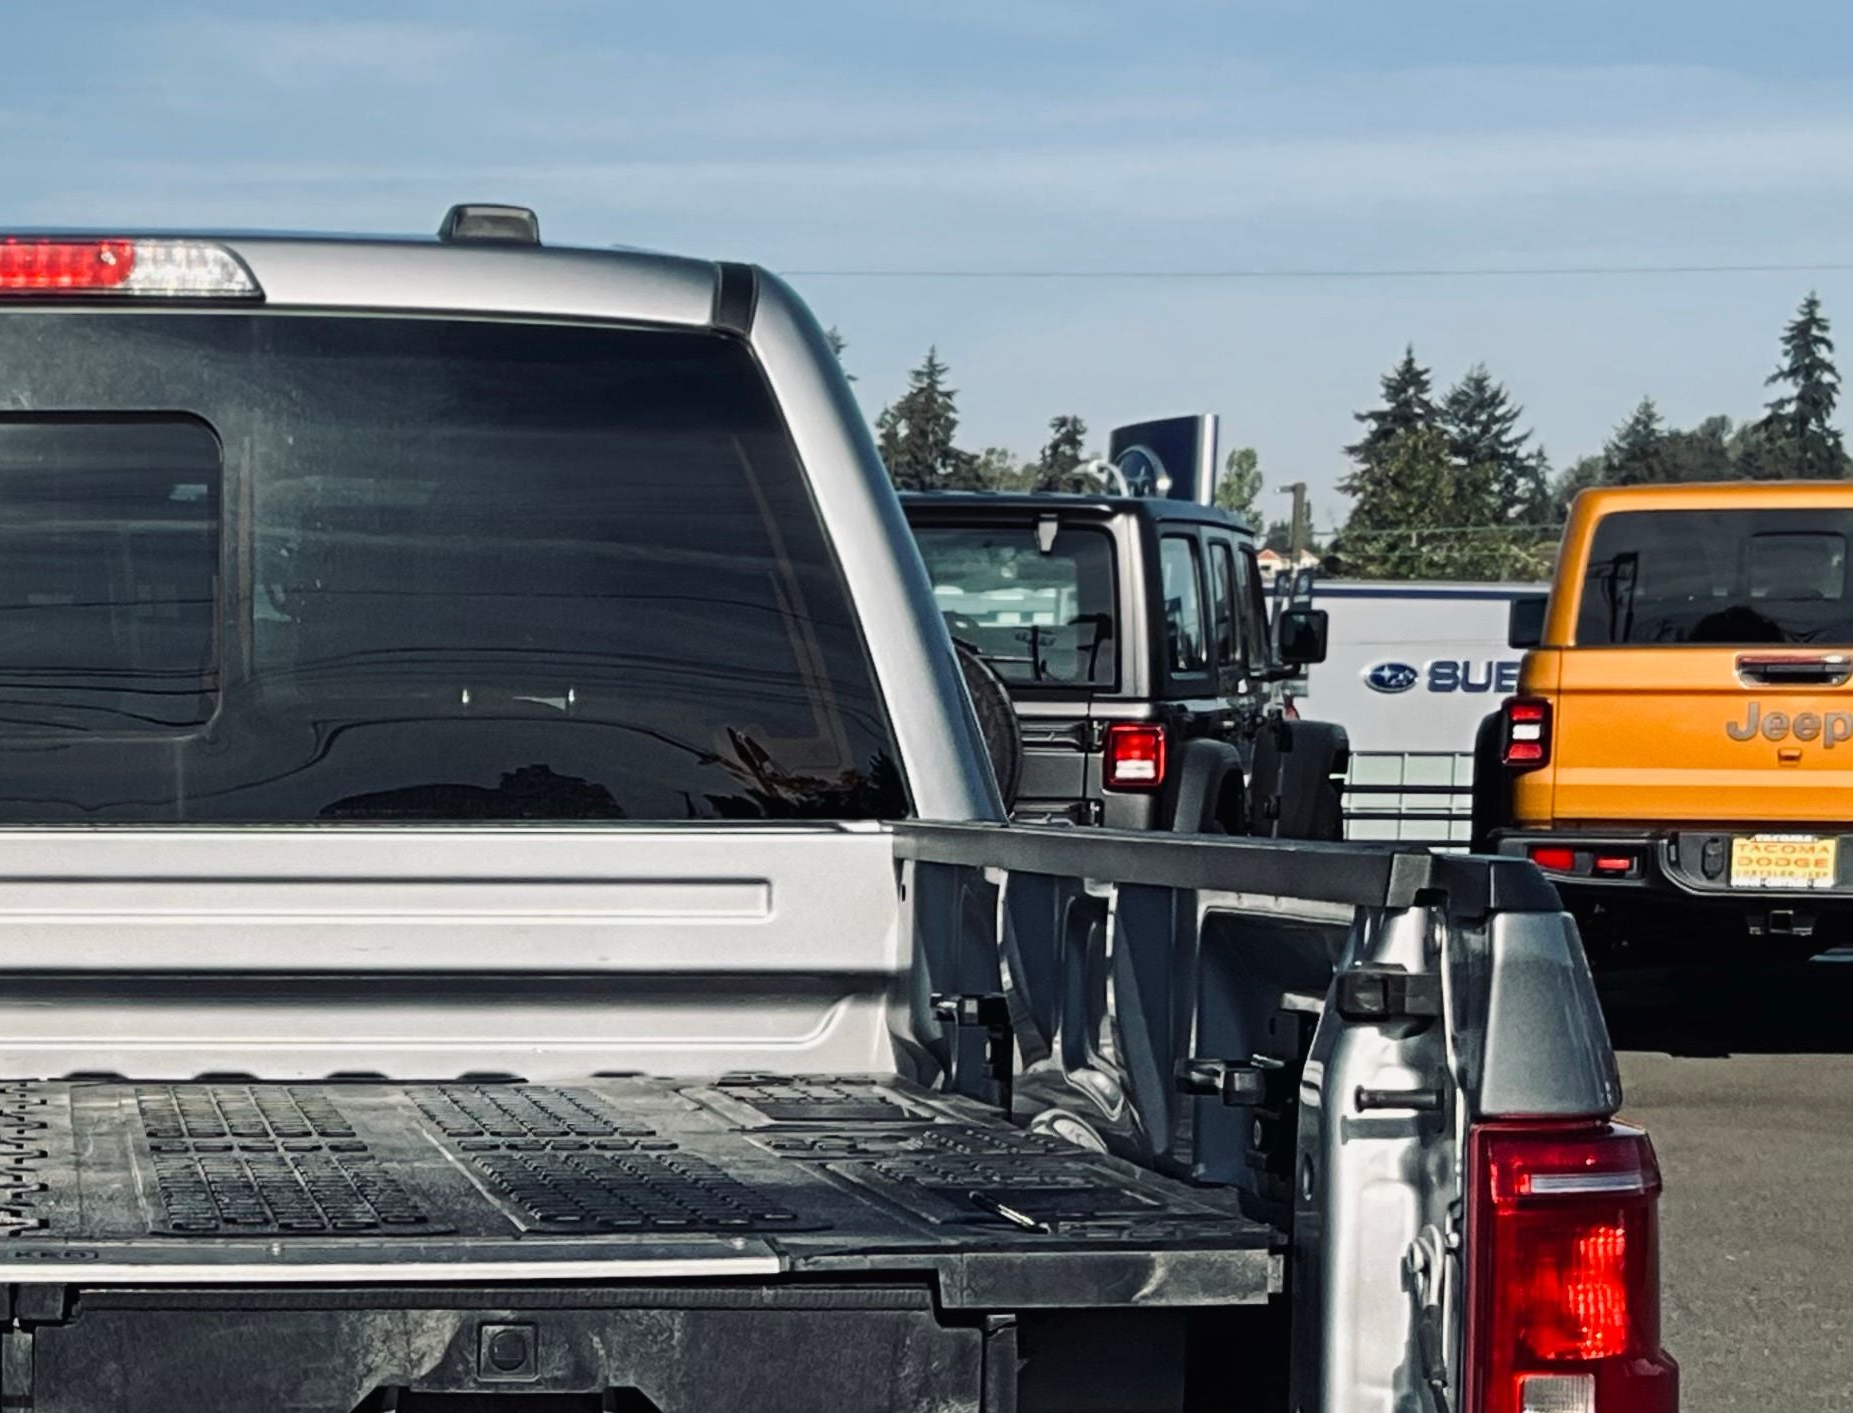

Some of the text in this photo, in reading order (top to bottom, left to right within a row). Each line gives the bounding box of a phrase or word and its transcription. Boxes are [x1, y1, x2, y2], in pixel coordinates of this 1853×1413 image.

[1726, 701, 1853, 749] Jeep
[1736, 843, 1829, 855] TACOMA
[1737, 856, 1828, 868] DODGE
